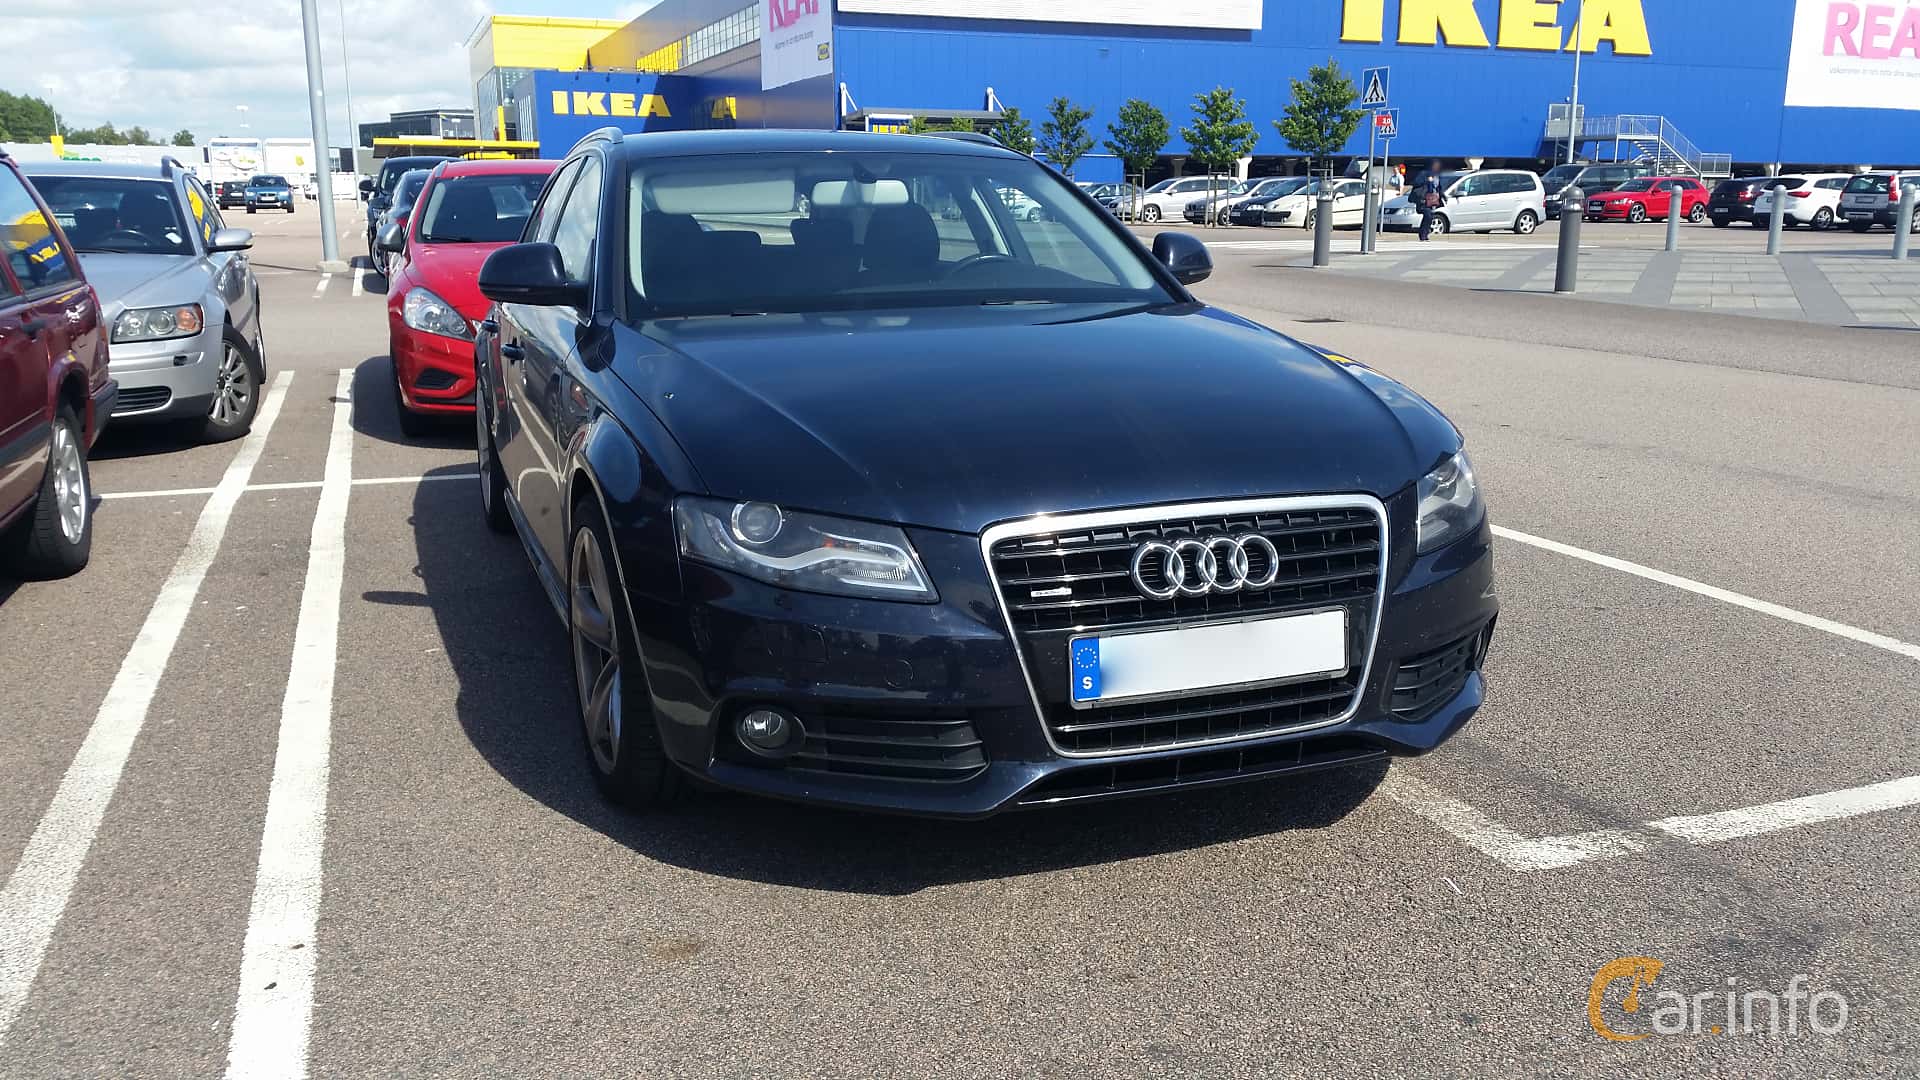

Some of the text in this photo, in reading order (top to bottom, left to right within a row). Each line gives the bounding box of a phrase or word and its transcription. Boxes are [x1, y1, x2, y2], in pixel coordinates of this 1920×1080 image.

[1340, 0, 1653, 54] IKEA
[552, 91, 671, 117] IKEA
[1082, 676, 1093, 690] S
